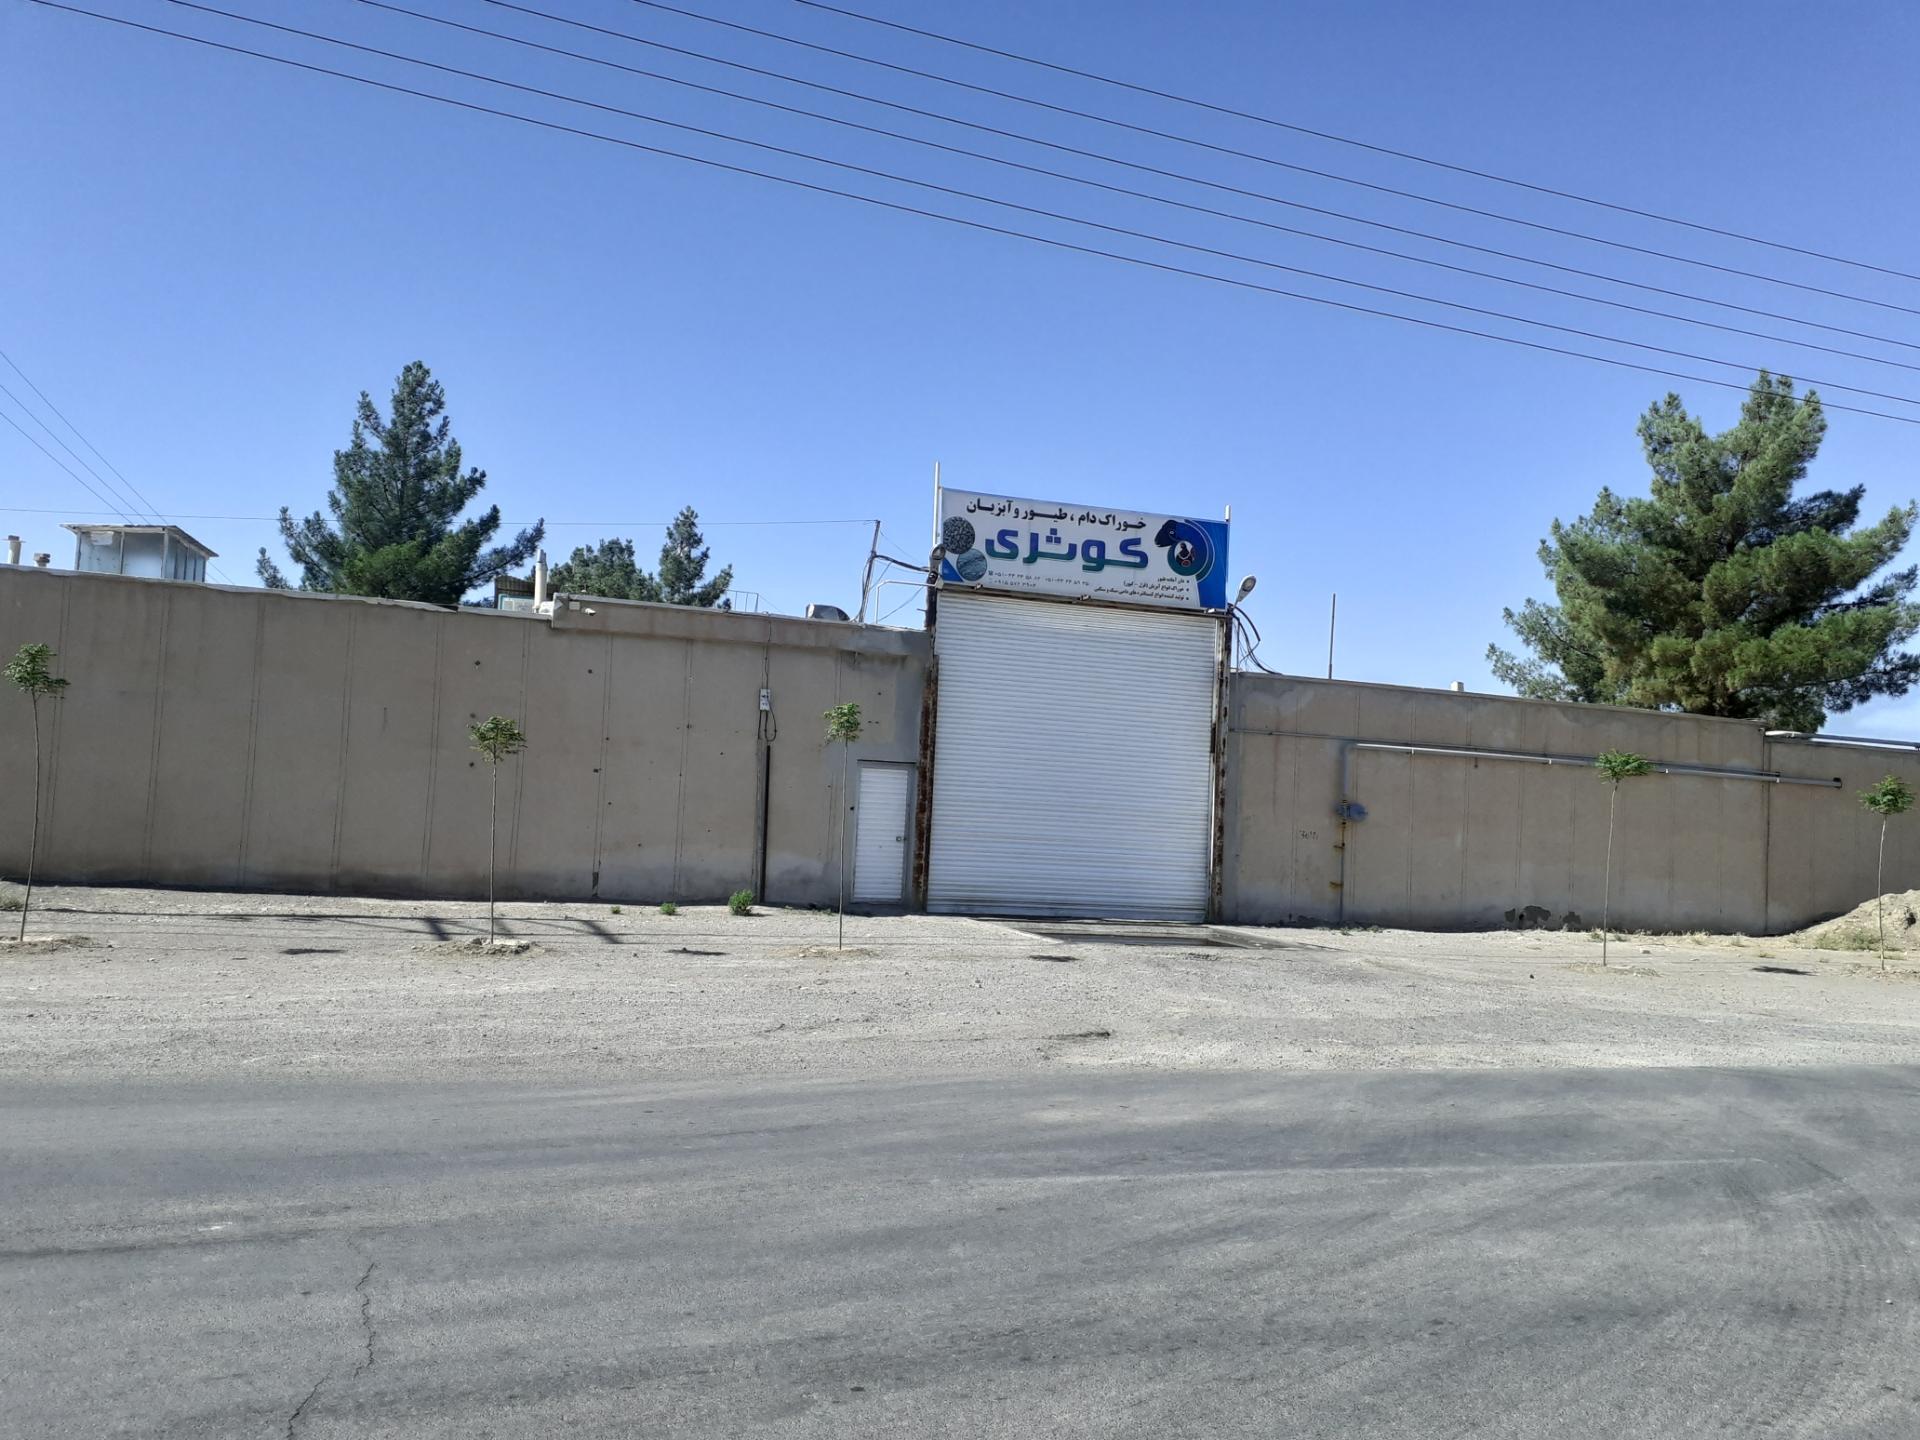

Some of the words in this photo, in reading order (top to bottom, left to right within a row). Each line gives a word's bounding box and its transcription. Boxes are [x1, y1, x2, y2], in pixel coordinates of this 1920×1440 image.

[966, 498, 1014, 517] آبزیان
[1013, 507, 1020, 519] و
[1021, 507, 1068, 523] طیور
[1098, 514, 1146, 532] خوراک
[985, 528, 1149, 572] کوثری
